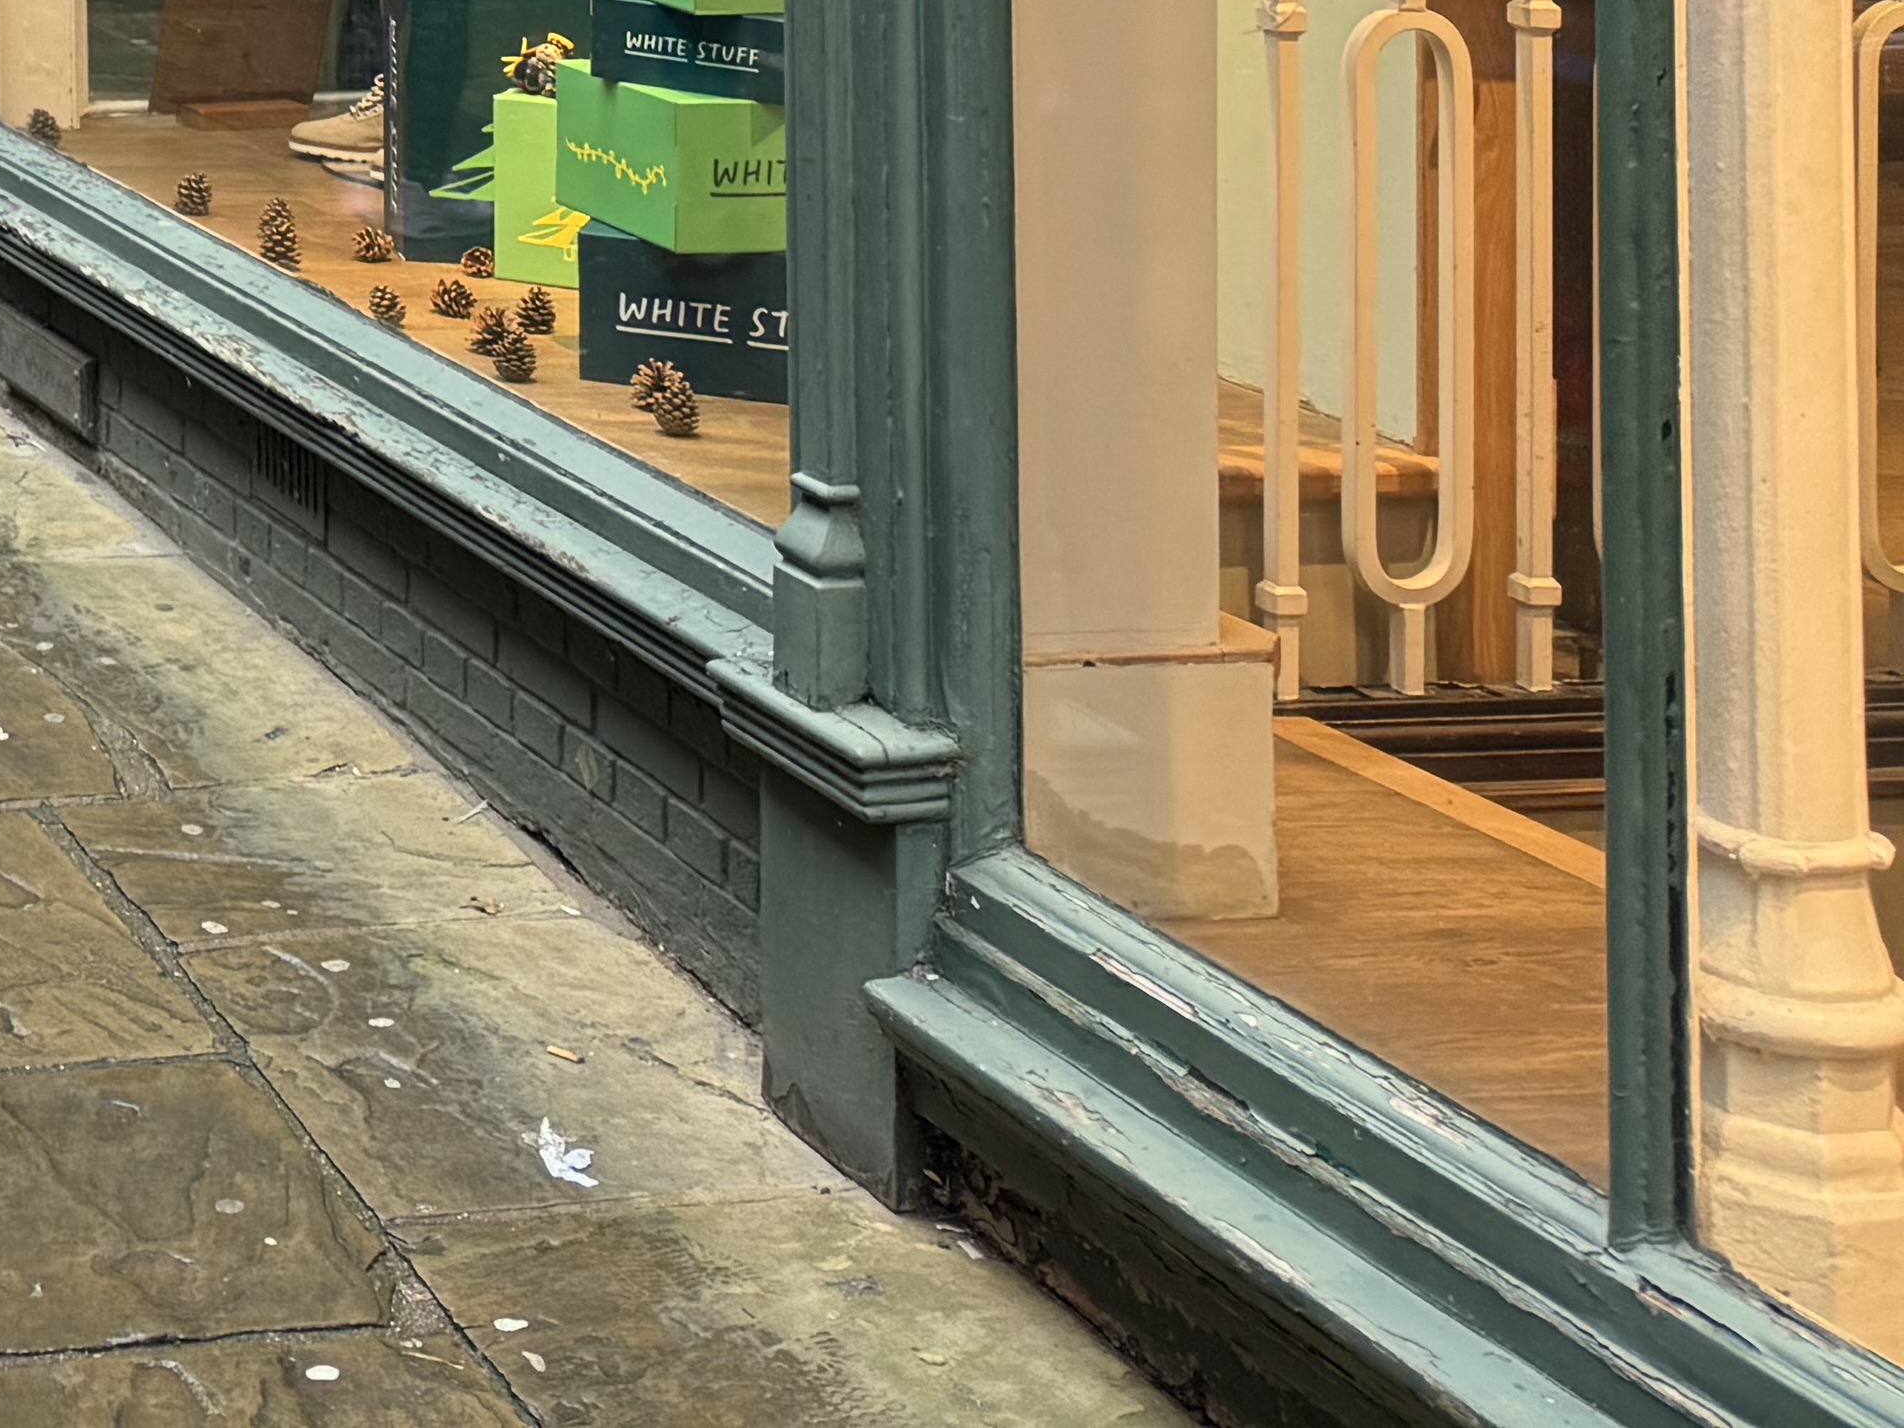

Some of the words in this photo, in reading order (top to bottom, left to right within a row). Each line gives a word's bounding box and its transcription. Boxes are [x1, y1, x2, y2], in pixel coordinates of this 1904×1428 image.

[625, 30, 688, 57] WHITE
[696, 40, 760, 66] STUFF
[618, 291, 732, 333] WHITE
